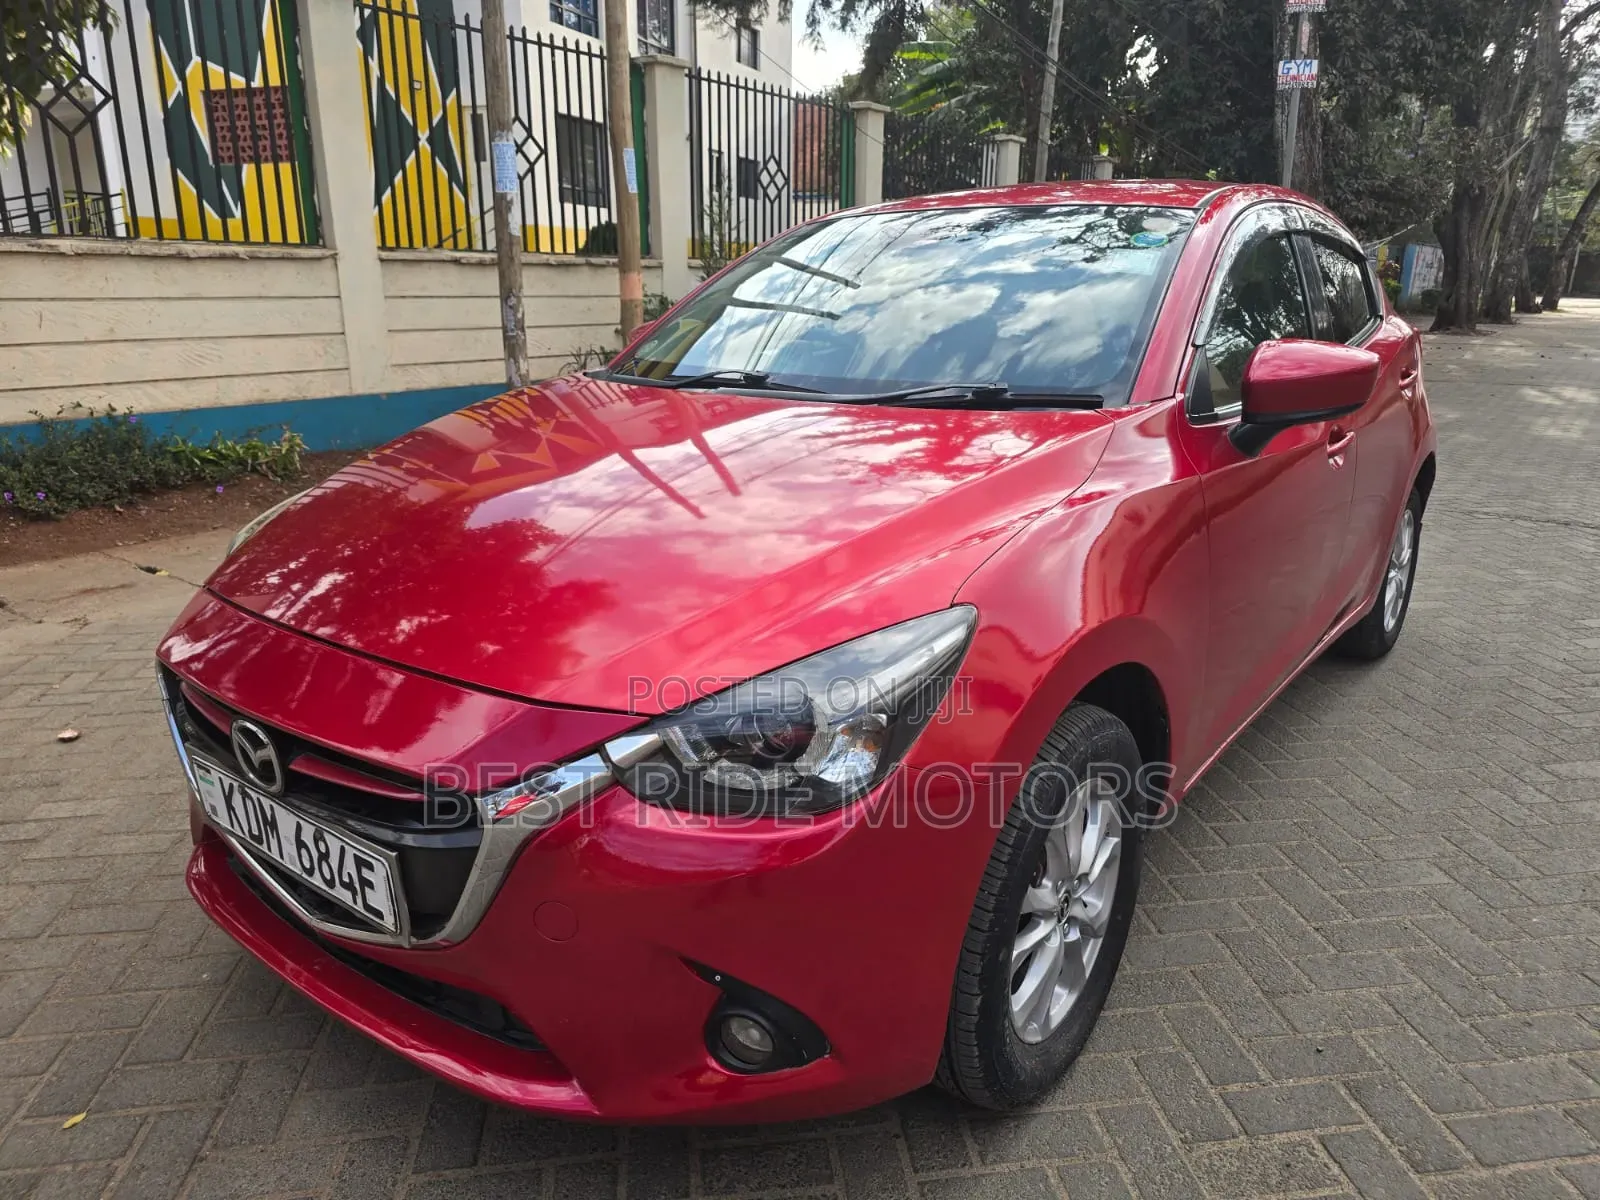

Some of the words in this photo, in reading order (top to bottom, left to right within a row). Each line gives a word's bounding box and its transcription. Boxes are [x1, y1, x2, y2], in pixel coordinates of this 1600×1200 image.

[1282, 60, 1313, 75] GYM
[219, 776, 284, 861] KDM
[295, 820, 385, 922] 684E
